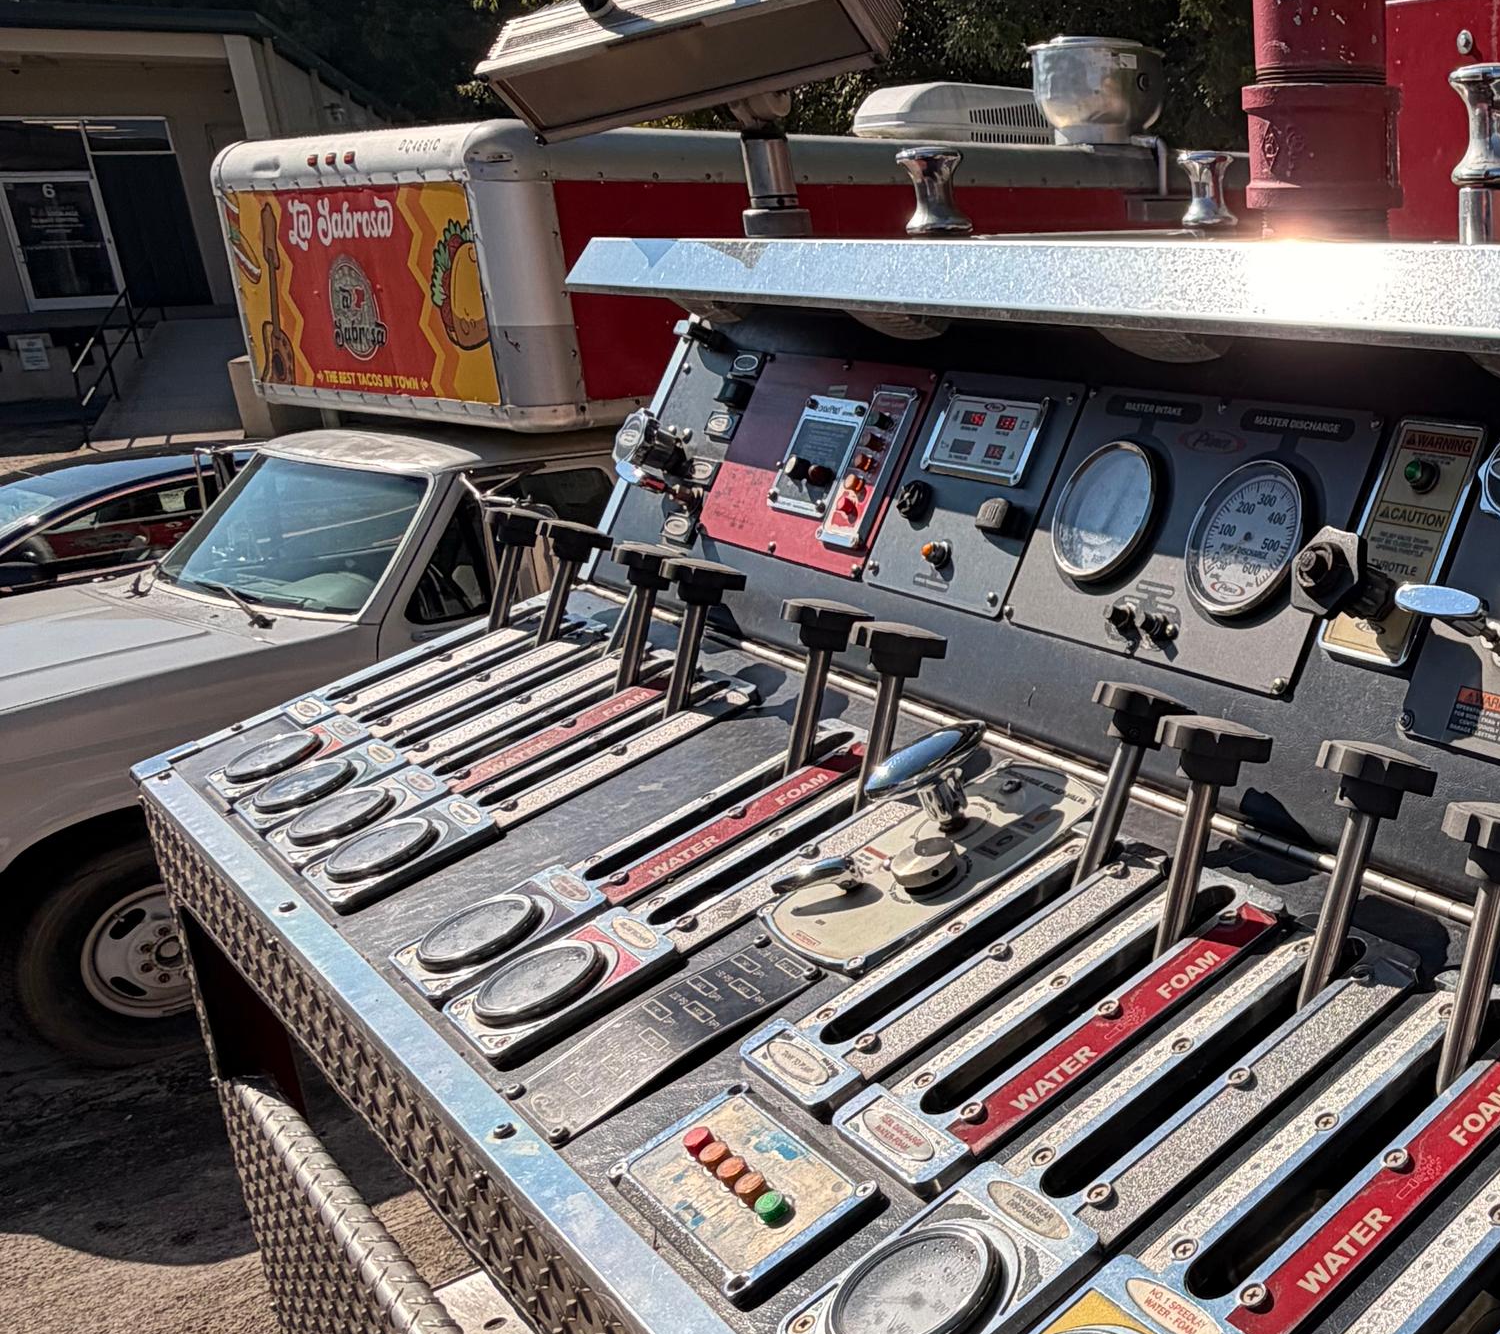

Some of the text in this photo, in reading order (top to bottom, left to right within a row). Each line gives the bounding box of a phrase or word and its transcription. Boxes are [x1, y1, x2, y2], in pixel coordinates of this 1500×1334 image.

[42, 183, 56, 198] 6
[288, 196, 394, 251] La Sabrosa
[324, 369, 420, 390] THE BEST TACOS IN TOWN
[1125, 402, 1183, 417] MASTER INTAKE
[1254, 415, 1341, 434] MASTER DISCHARGE
[1418, 433, 1473, 453] WARNING
[1236, 501, 1255, 515] 200
[1257, 493, 1277, 507] 300
[1268, 512, 1287, 525] 400
[1390, 507, 1446, 528] CAUTION
[1218, 523, 1237, 537] 100
[1261, 538, 1280, 552] 500
[1242, 564, 1261, 576] 600
[601, 691, 651, 718] FOAM
[774, 773, 829, 806] FOAM
[648, 834, 721, 879] WATER
[1156, 950, 1221, 1001] FOAM
[1009, 1045, 1098, 1112] WATER
[1013, 1190, 1038, 1209] DRIVER
[1296, 1207, 1393, 1295] WATER
[1144, 1296, 1171, 1321] WATER
[1149, 1287, 1208, 1330] NO. 1 SPEEDLAY
